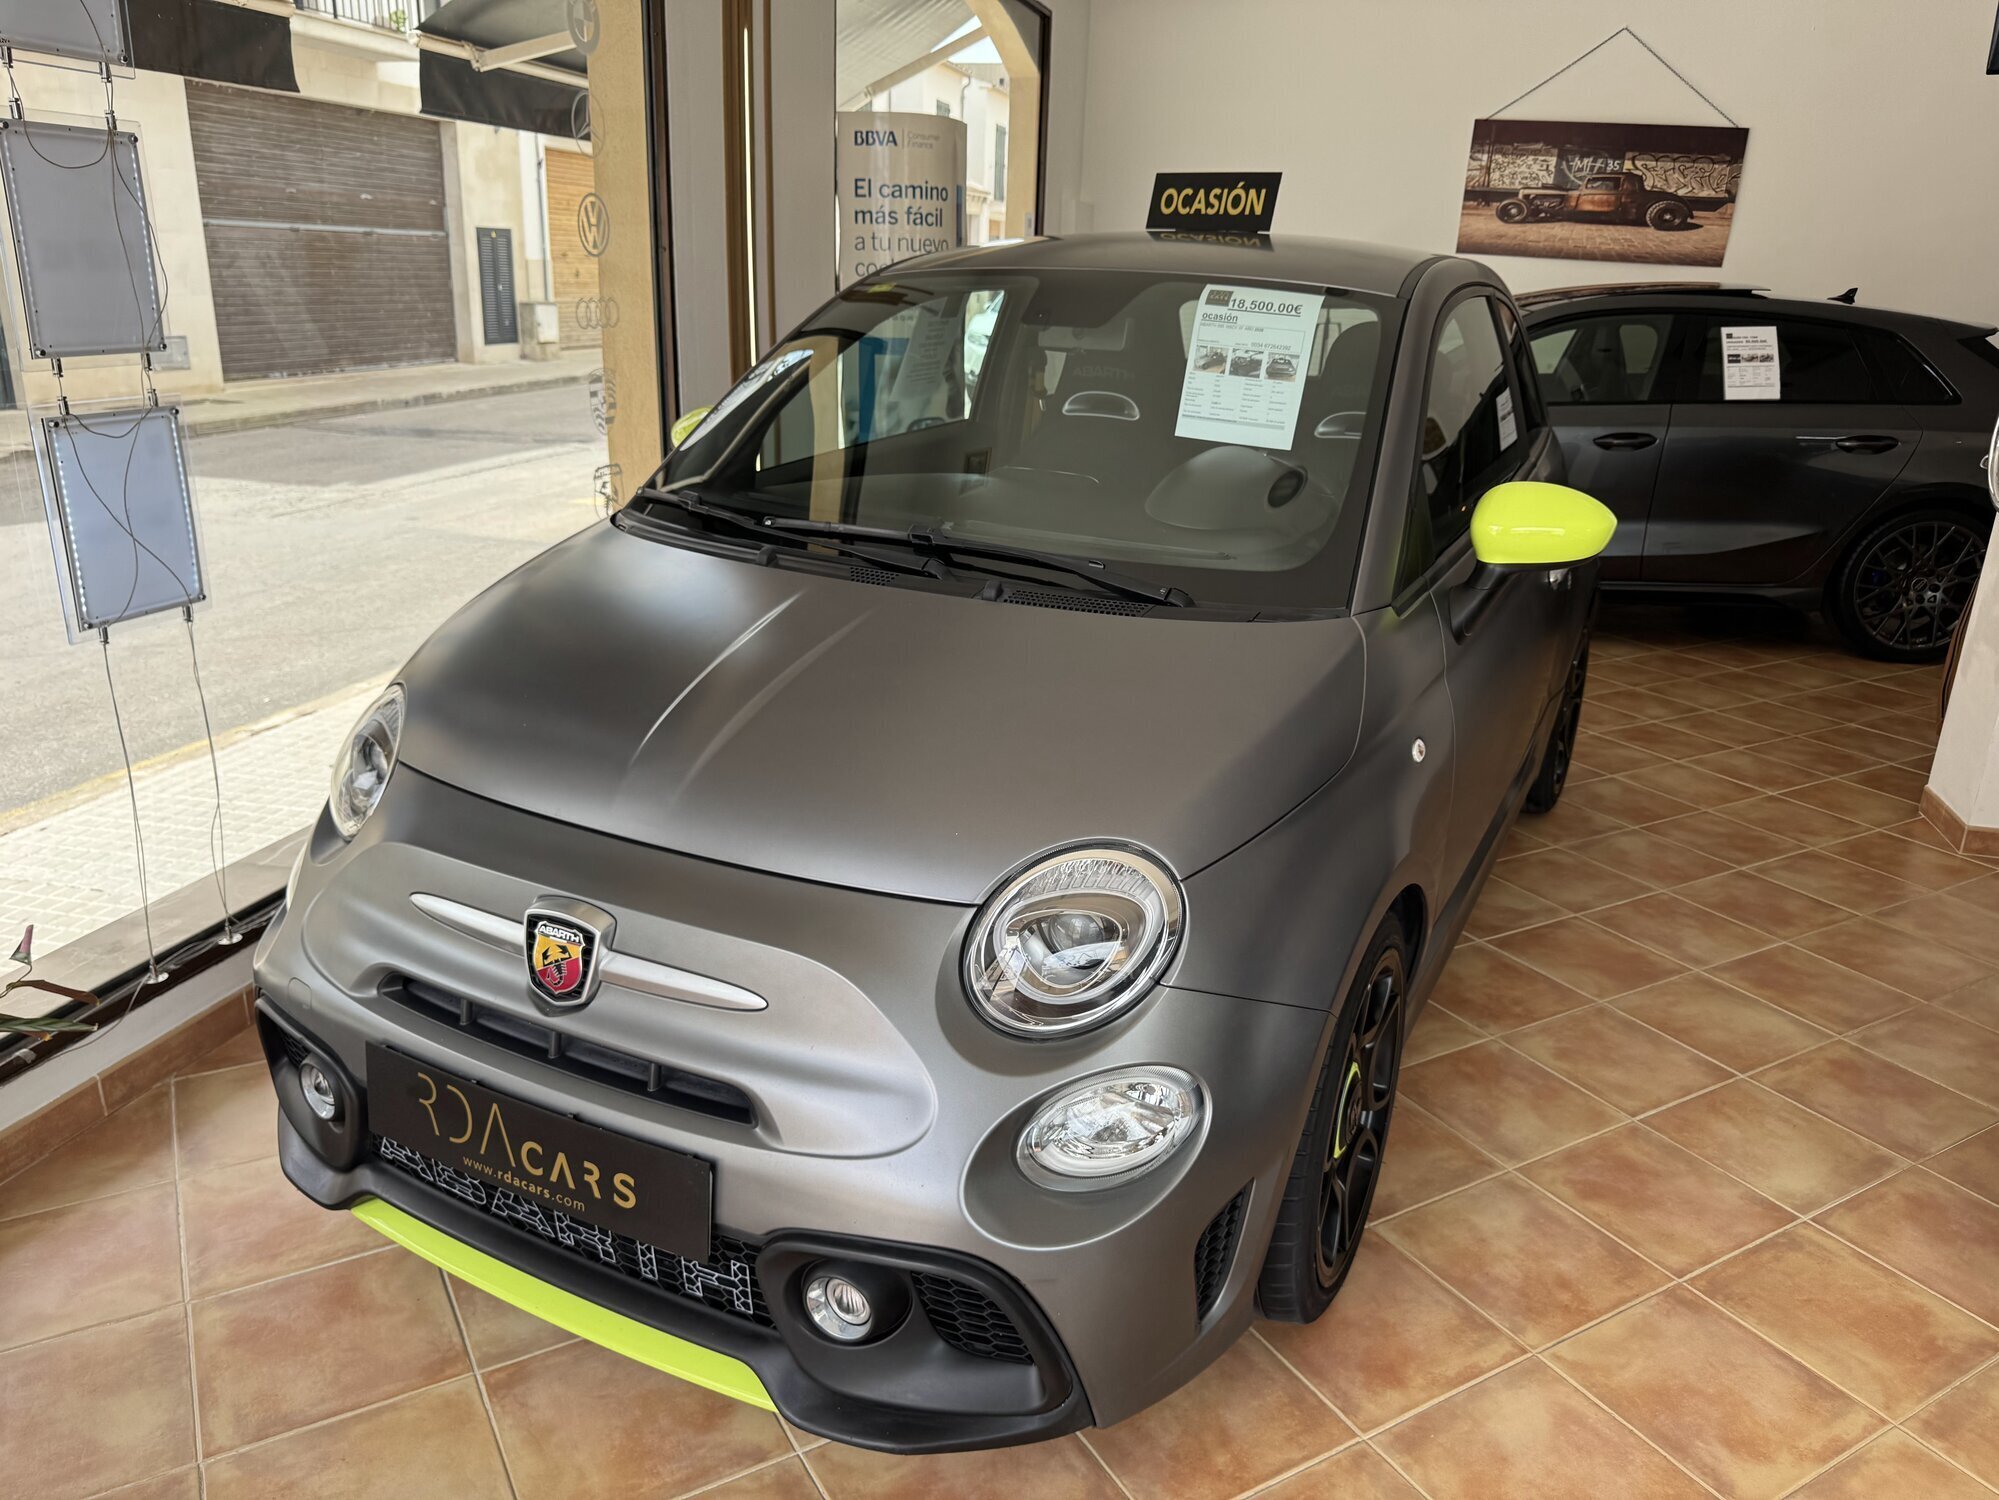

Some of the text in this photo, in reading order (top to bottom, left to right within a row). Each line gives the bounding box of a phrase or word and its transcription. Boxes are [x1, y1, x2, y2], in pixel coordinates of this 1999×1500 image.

[854, 130, 898, 147] BBVA
[854, 178, 948, 202] El camino
[1160, 181, 1266, 216] OCASIÓN
[854, 205, 943, 227] más fácil
[854, 232, 949, 253] a tu nuevo
[1201, 311, 1239, 323] ocasión
[1230, 298, 1303, 315] 18,500.00€
[539, 925, 579, 943] ABARTH
[462, 1154, 586, 1212] www.rdacars.com
